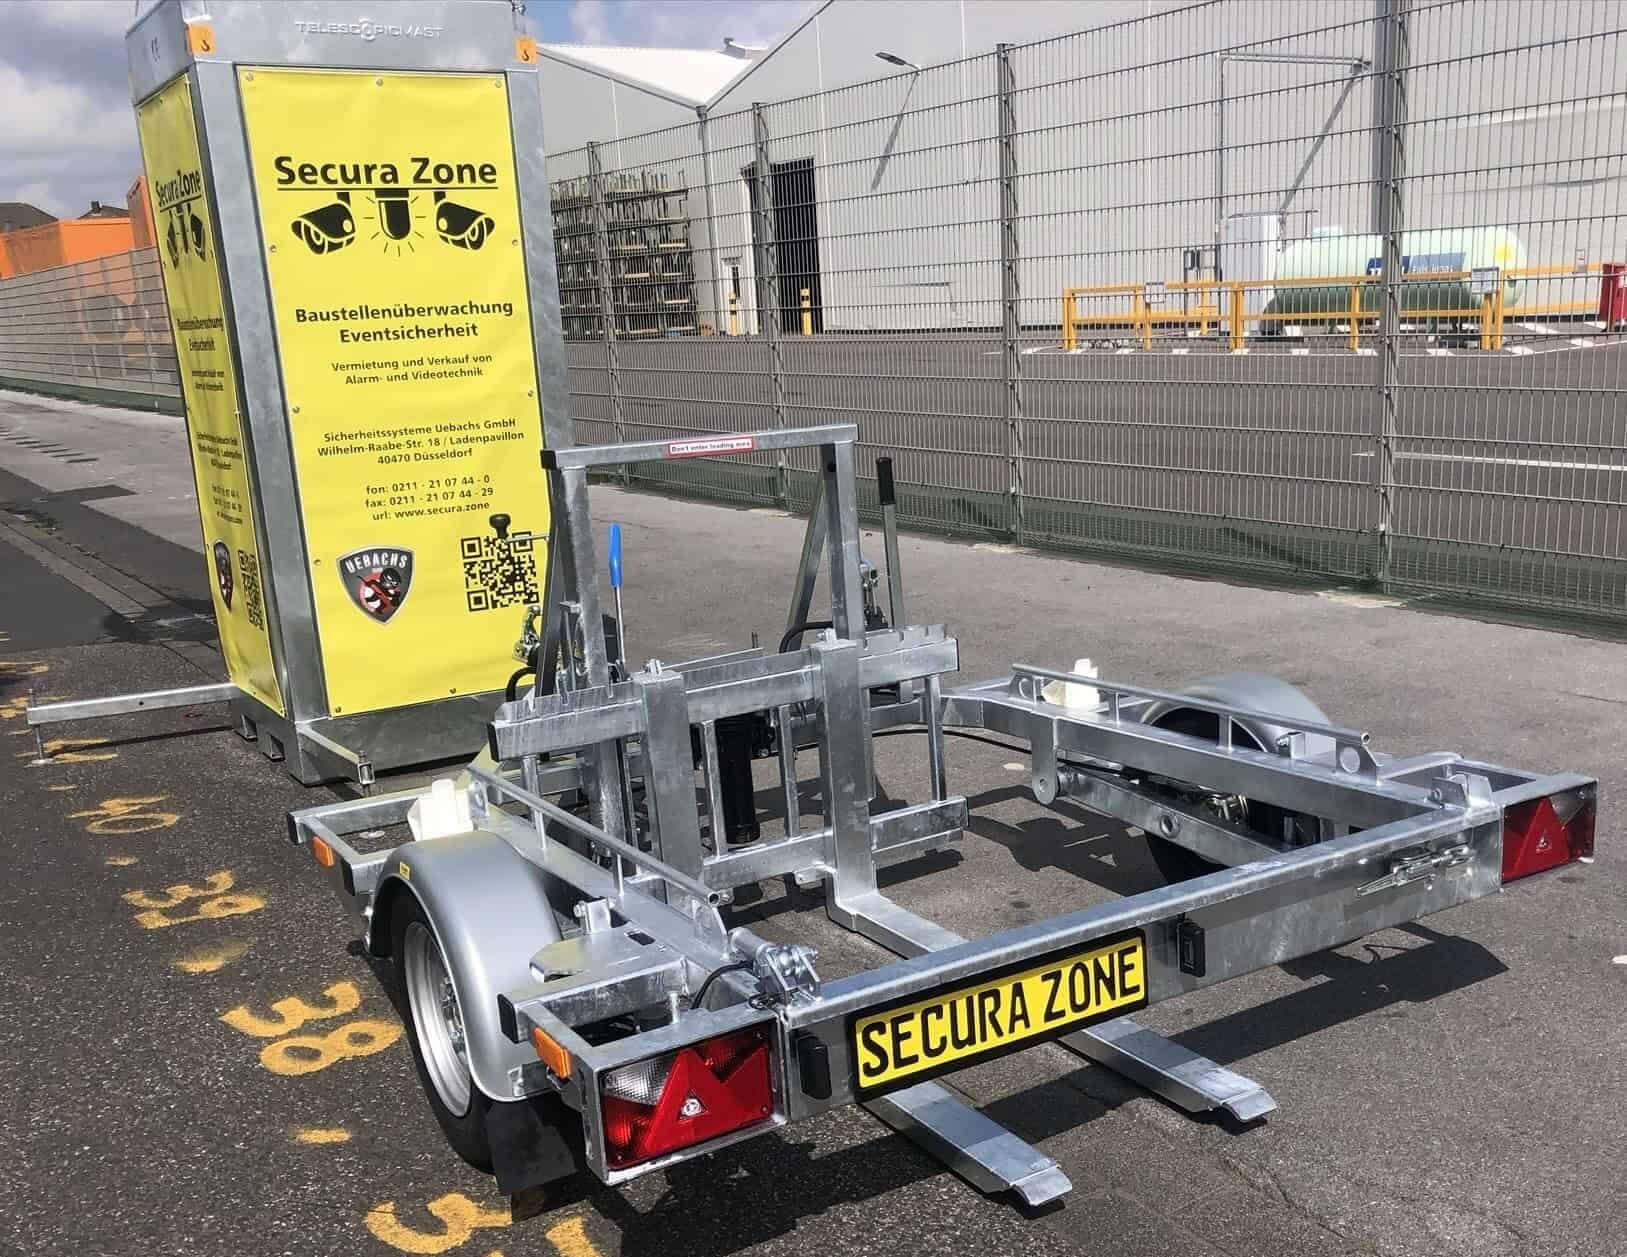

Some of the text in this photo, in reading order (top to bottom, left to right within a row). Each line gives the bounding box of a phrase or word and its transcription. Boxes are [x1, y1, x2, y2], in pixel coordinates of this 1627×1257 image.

[274, 155, 497, 185] Secura Zone
[176, 169, 201, 197] Zone
[295, 300, 513, 323] Baustellenüberwachung
[340, 322, 478, 343] Eventsicherheit
[332, 354, 492, 372] Vermietung und Verkauf von
[345, 367, 483, 385] Alarm- und Videotechnik
[324, 418, 516, 443] Sicherheitssysteme Uebachs GmbH
[317, 439, 424, 457] Wilhelm-Raabe-Str.
[429, 437, 441, 447] 18
[450, 431, 524, 446] Ladenpavillon
[377, 447, 473, 464] 40470 Düsseldorf
[366, 483, 389, 495] fon:
[392, 481, 417, 492] 0211
[429, 479, 441, 489] 21
[444, 477, 457, 488] 07
[461, 476, 474, 486] 44
[483, 474, 491, 484] 0
[365, 497, 387, 509] fax:
[389, 494, 416, 506] 0211
[426, 492, 439, 502] 21
[442, 490, 455, 501] 07
[459, 489, 472, 499] 44
[481, 487, 494, 497] 29
[372, 501, 490, 521] url: www.secura.zone
[345, 552, 408, 573] UEBACHS
[861, 945, 1140, 1078] SECURA ZONE
[219, 981, 403, 1076] 38
